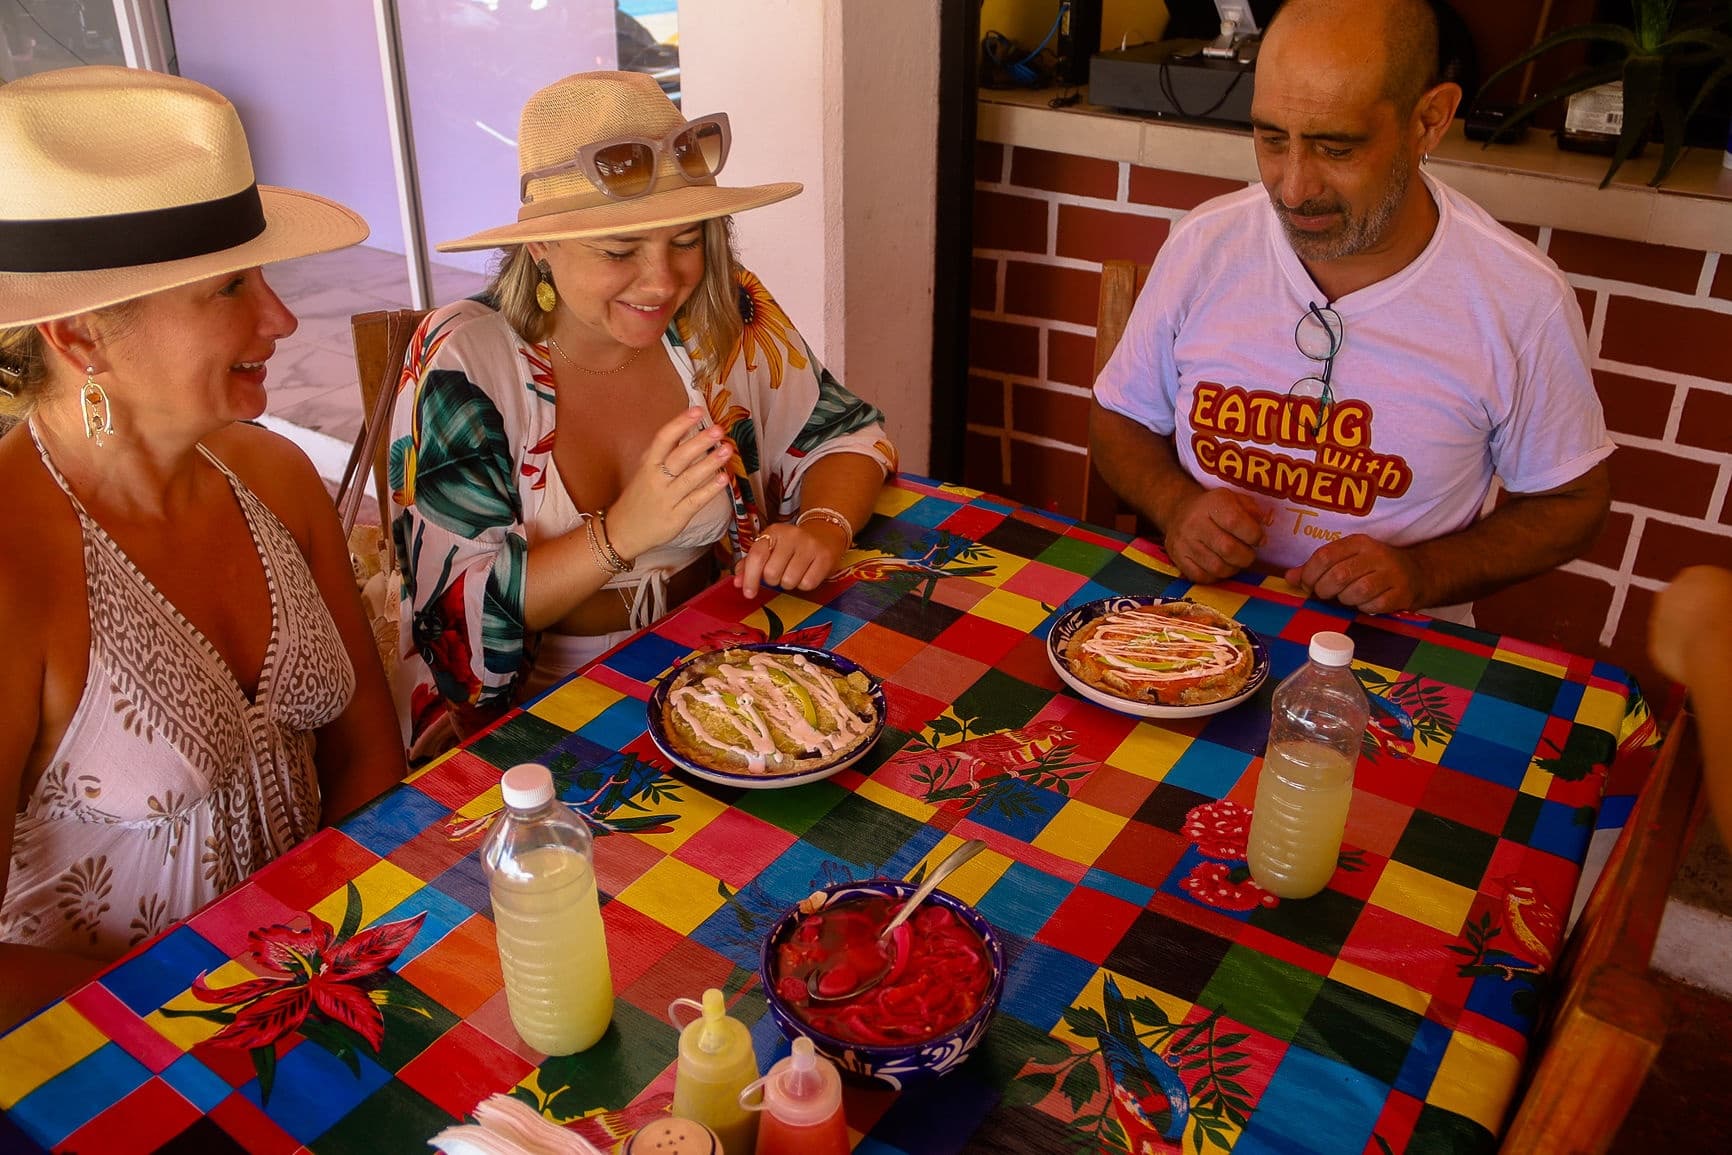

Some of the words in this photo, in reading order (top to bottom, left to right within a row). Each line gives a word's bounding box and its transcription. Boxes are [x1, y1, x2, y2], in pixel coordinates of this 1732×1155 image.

[1194, 388, 1363, 447] EATING
[1196, 439, 1369, 509] CARMEN
[1323, 447, 1401, 490] with
[1285, 507, 1342, 542] Tours
